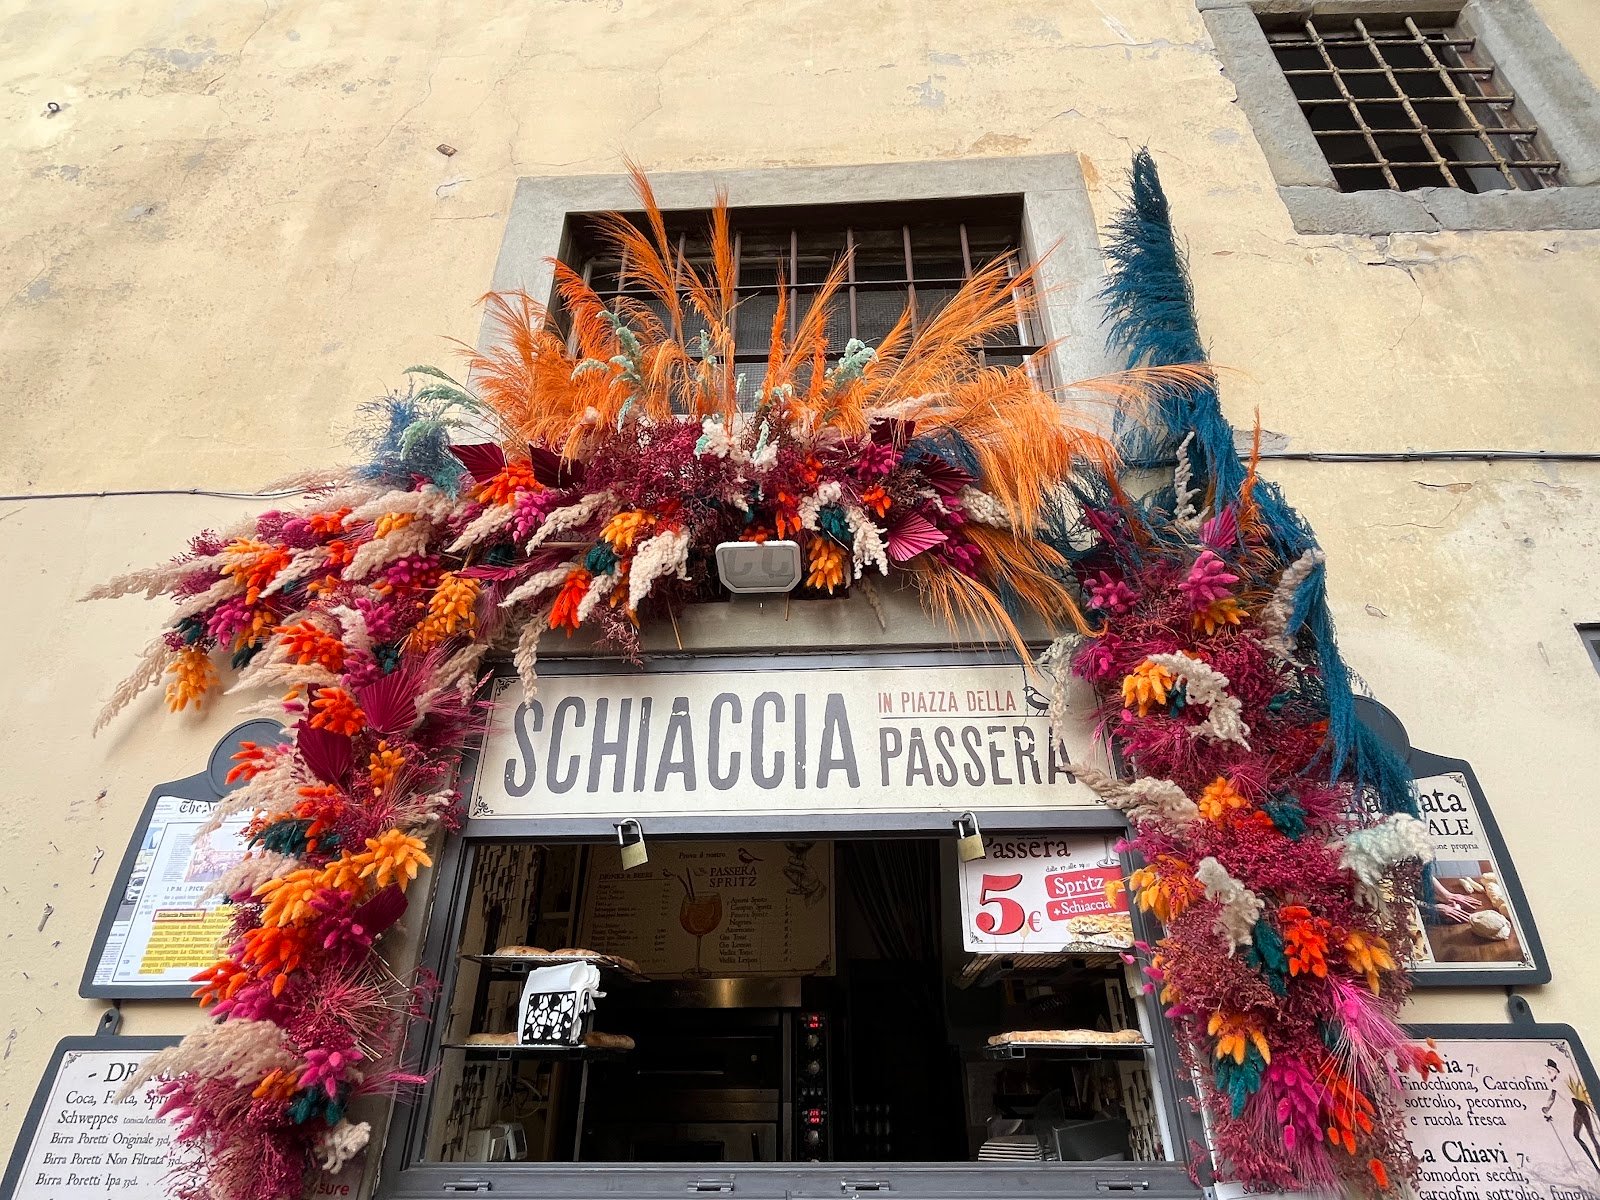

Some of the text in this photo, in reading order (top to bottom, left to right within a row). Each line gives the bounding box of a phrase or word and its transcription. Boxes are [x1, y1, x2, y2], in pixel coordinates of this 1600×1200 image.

[878, 690, 1017, 713] IN PIAZZA DELLA
[503, 691, 861, 797] SCHIACCIA
[879, 725, 1077, 787] PASSERA
[1451, 843, 1480, 853] propria
[709, 866, 758, 877] PASSERA
[709, 877, 757, 888] SPRITZ
[1054, 875, 1105, 897] Spritz
[1400, 1075, 1550, 1093] Finocchiona, Carciofini
[66, 1090, 97, 1106] Coca,
[1404, 1095, 1528, 1113] sott'olio, pecorino,
[57, 1110, 119, 1130] Schweppes
[1410, 1110, 1507, 1126] e rucola fresca
[50, 1132, 75, 1144] Birra
[77, 1132, 109, 1144] Poretti
[113, 1132, 154, 1150] Originale
[43, 1152, 67, 1165] Birra
[72, 1152, 103, 1165] Poretti
[105, 1152, 128, 1165] Non
[131, 1152, 165, 1165] Filtrata
[1441, 1140, 1509, 1163] Chiavi
[35, 1172, 62, 1186] Birra
[66, 1172, 103, 1186] Poretti
[105, 1173, 121, 1191] Ipa
[1415, 1166, 1530, 1184] Pomodori secchi,
